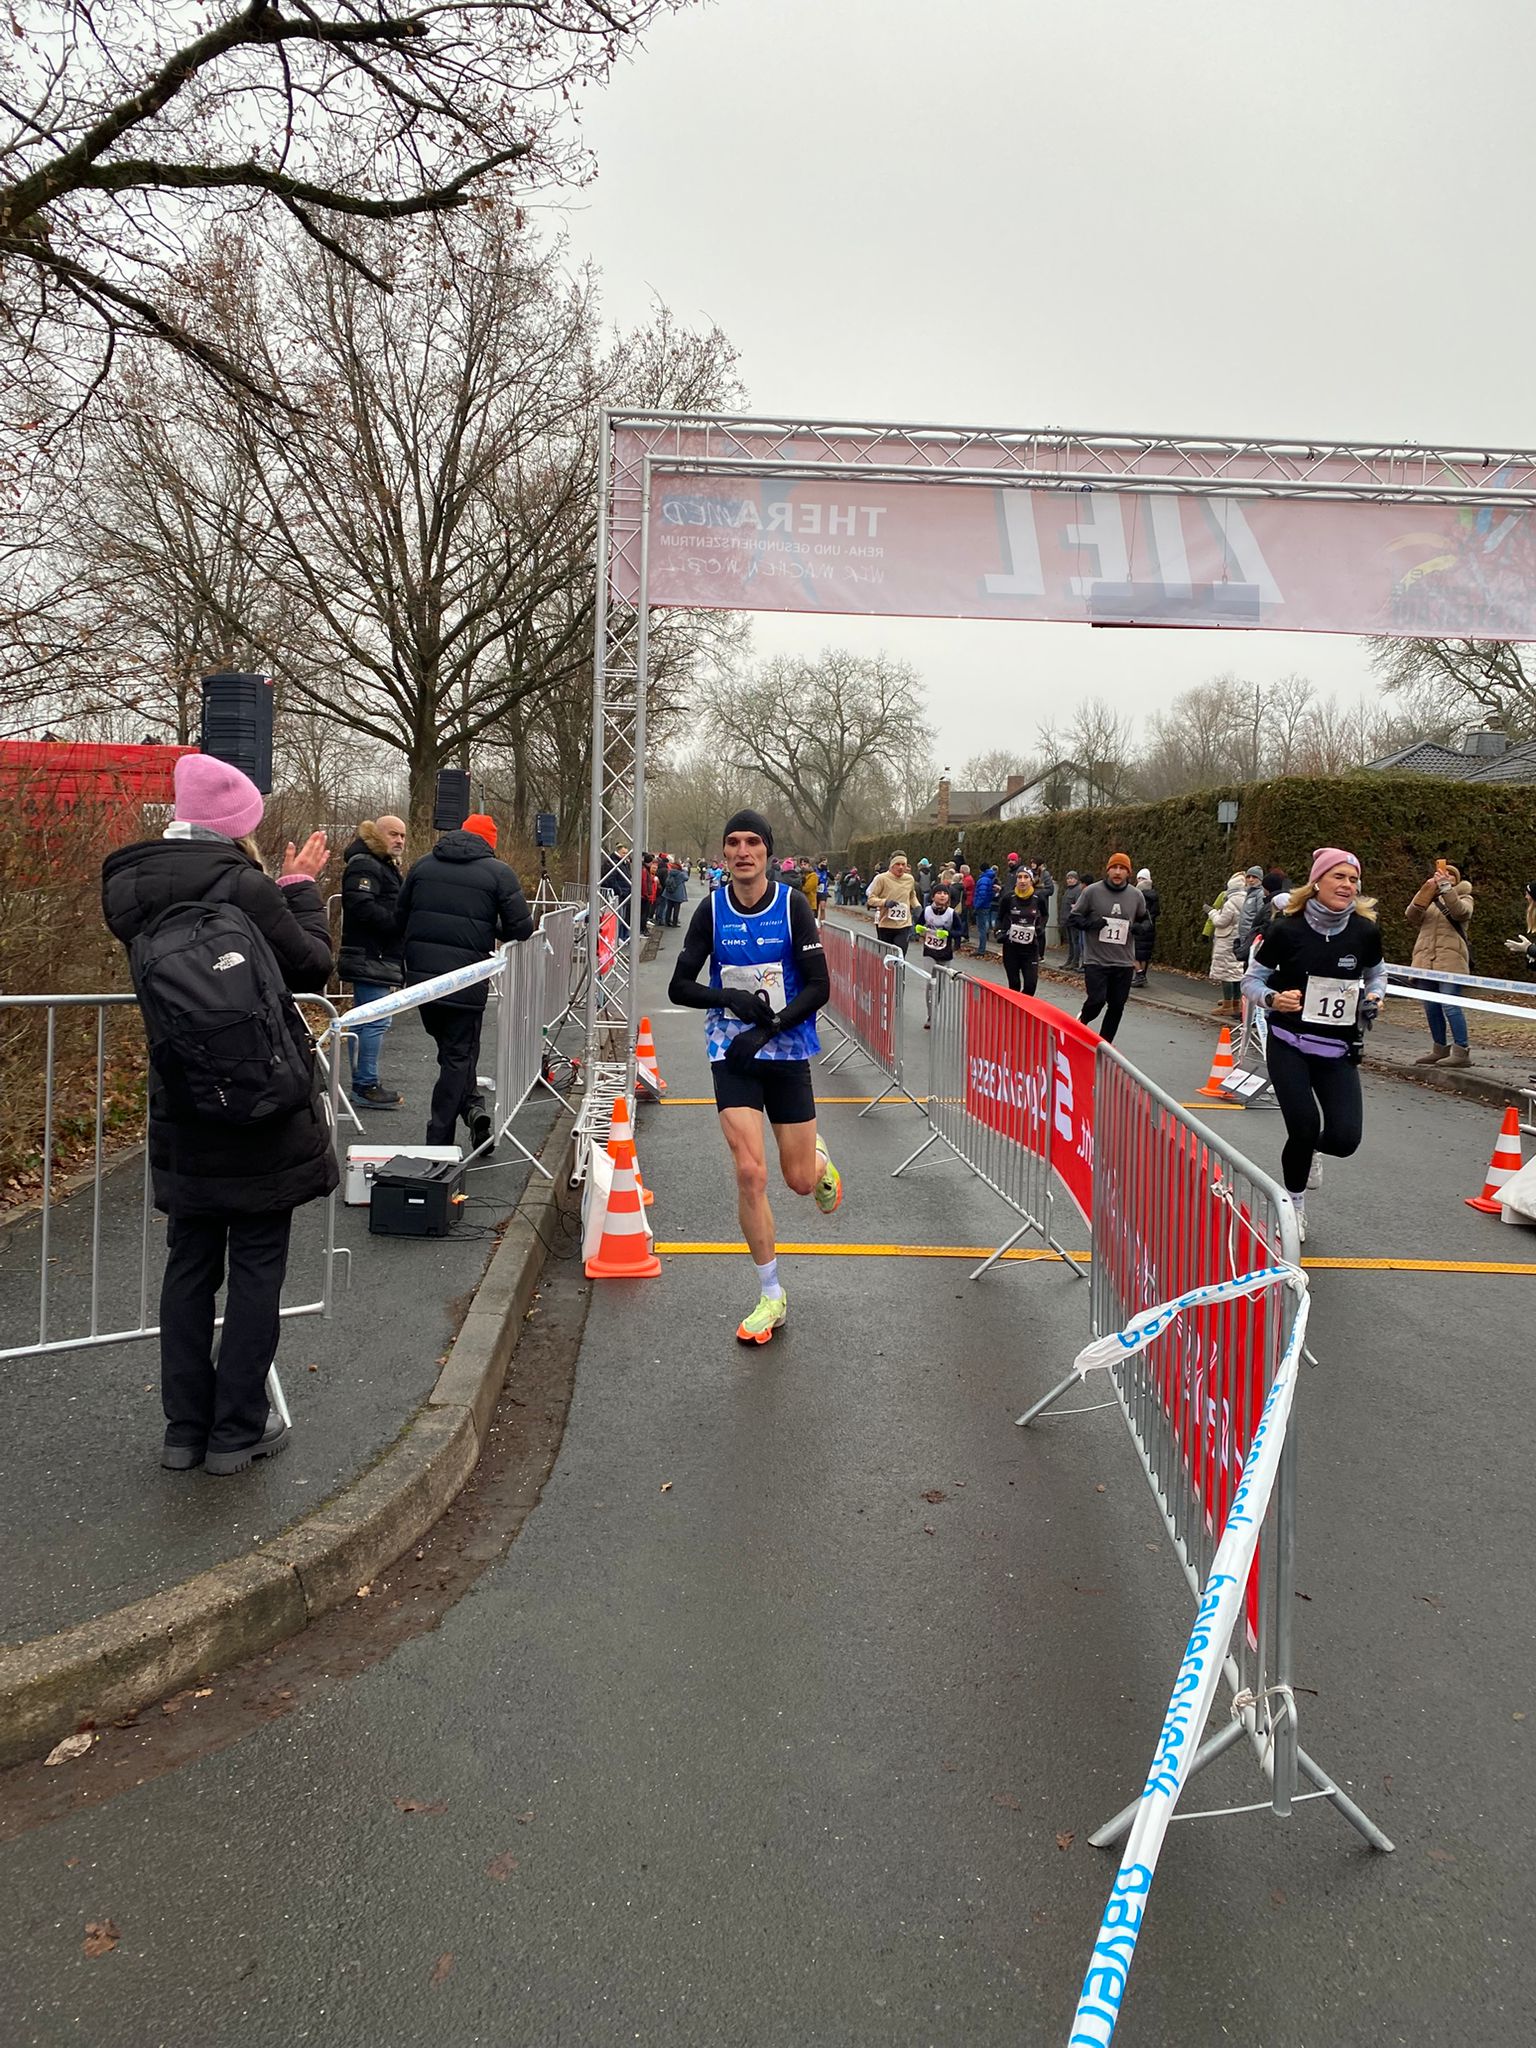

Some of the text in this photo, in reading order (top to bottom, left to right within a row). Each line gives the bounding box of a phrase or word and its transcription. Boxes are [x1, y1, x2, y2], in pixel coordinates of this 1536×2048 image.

[890, 909, 907, 919] 228
[1011, 929, 1031, 941] 283
[1106, 929, 1120, 940] 11
[927, 936, 944, 947] 282
[1317, 997, 1345, 1018] 18
